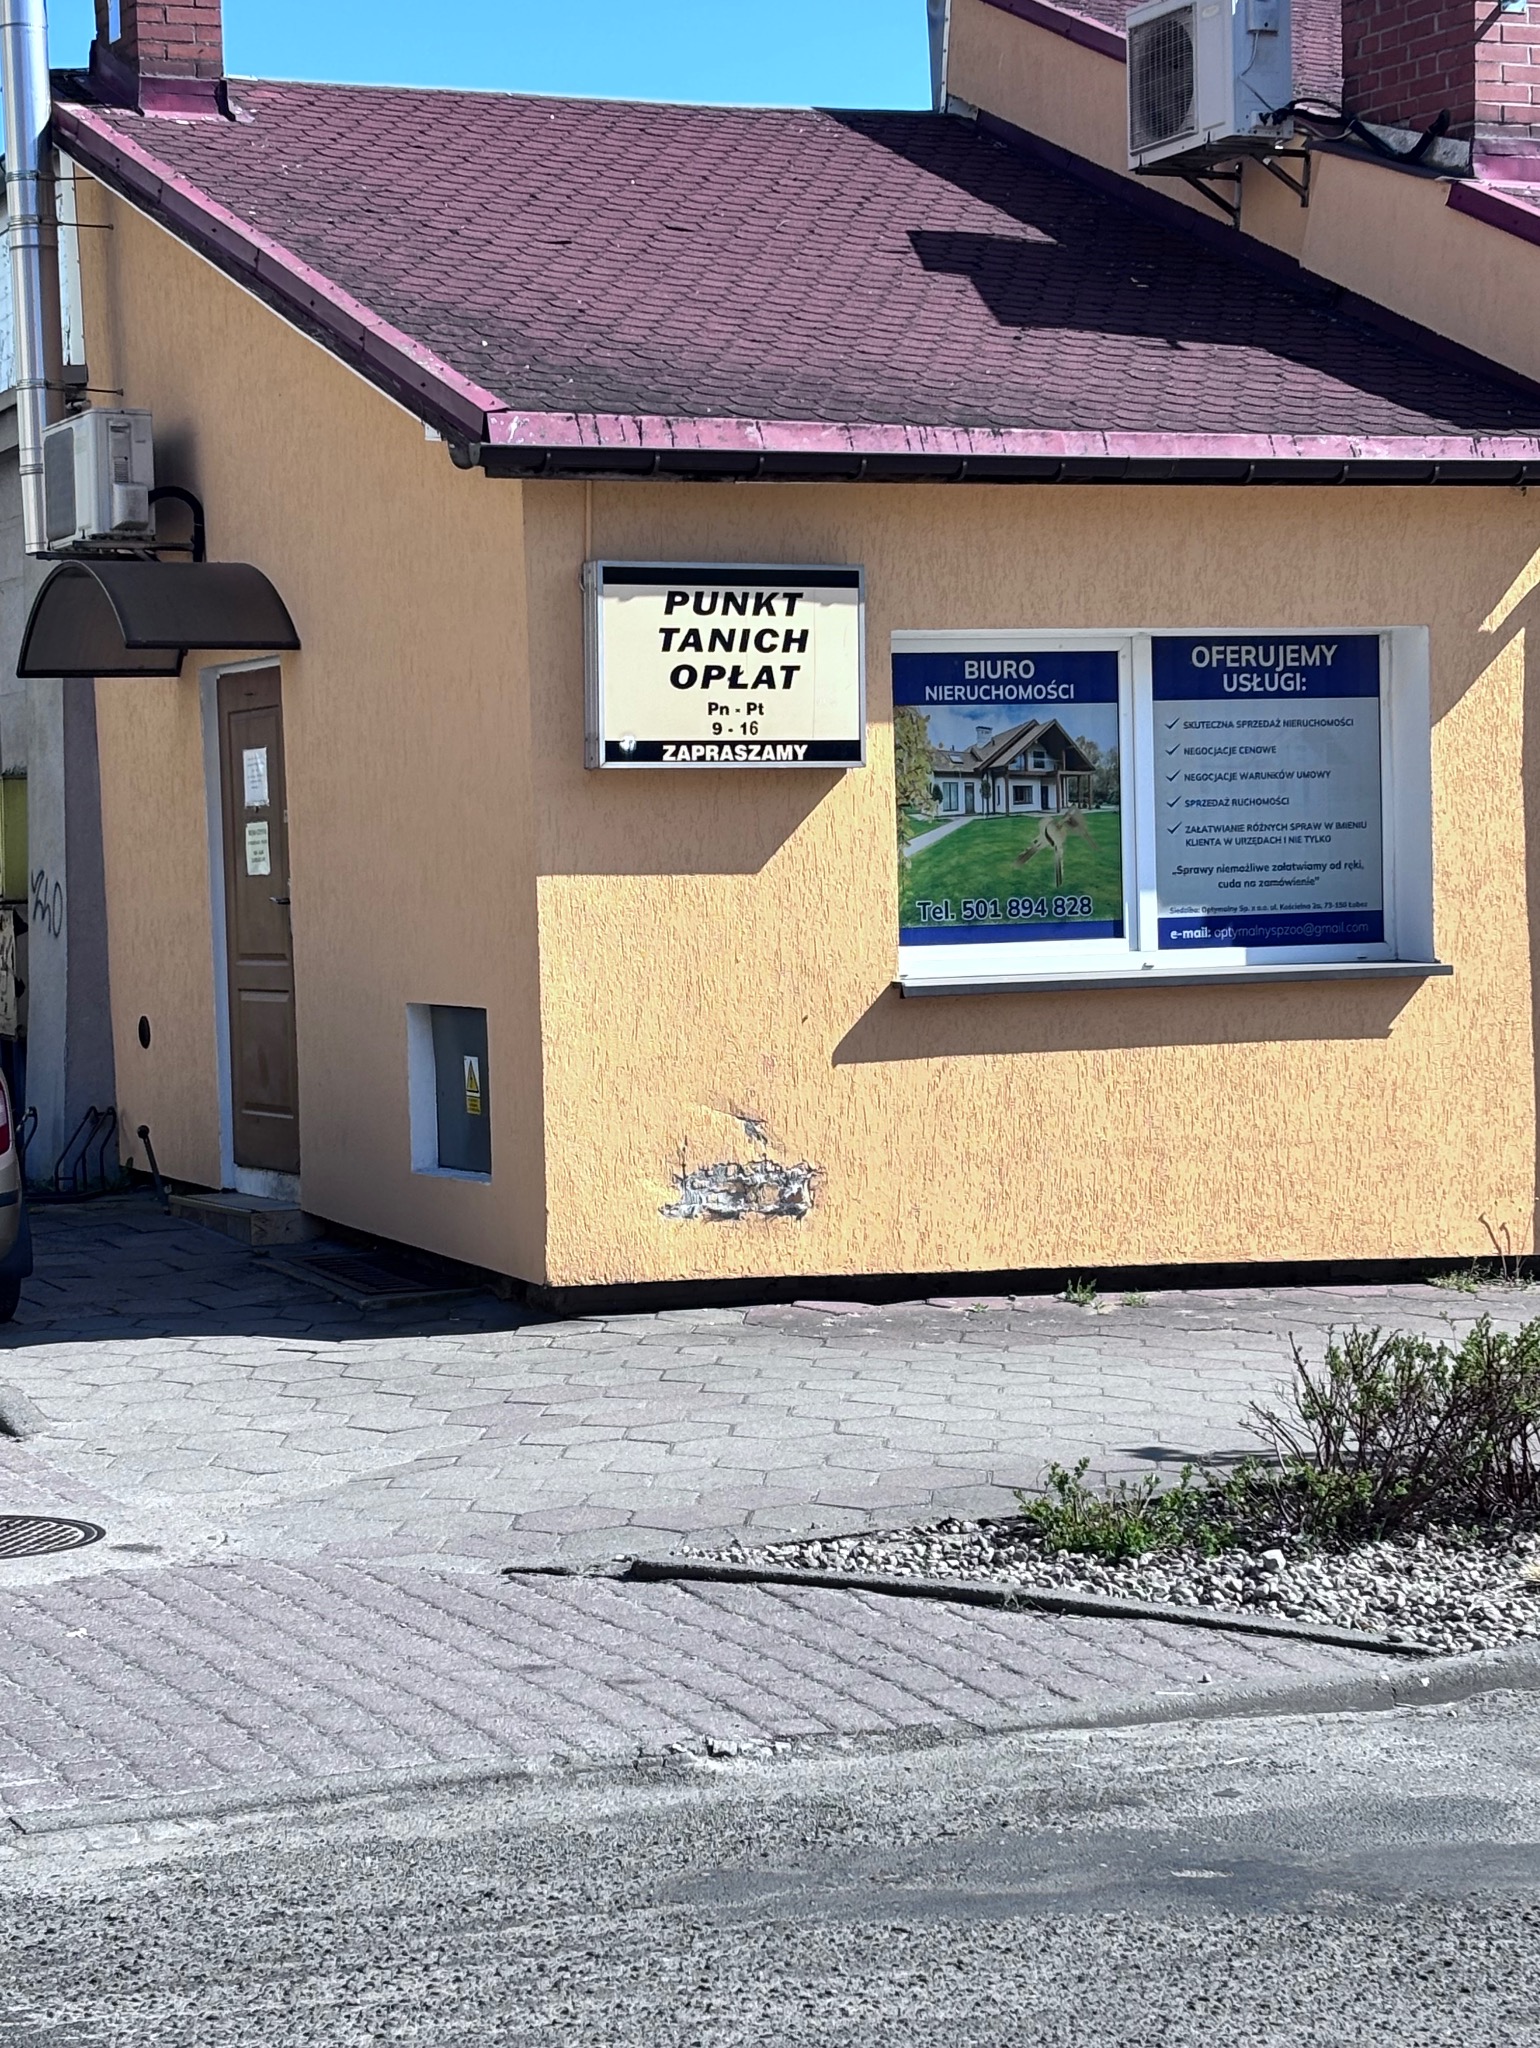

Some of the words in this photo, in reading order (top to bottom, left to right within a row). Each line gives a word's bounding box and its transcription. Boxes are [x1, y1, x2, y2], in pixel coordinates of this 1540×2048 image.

[664, 590, 804, 617] PUNKT
[658, 627, 809, 653] TANICH
[1191, 644, 1338, 671] OFERUJEMY
[669, 664, 801, 690] OPŁAT
[964, 659, 1035, 680] BIURO
[925, 680, 1075, 701] NIERUCHOMOŚCI
[1222, 673, 1307, 693] USŁUGI:
[707, 702, 730, 716] Pn
[746, 702, 764, 716] Pt
[712, 722, 723, 735] 9
[740, 721, 758, 735] 16
[1183, 721, 1235, 730] SKUTECZNA
[1236, 718, 1281, 728] SPRZEDAŻ
[1282, 717, 1354, 728] NIERUCHOMOŚCI
[662, 744, 808, 762] ZAPRASZAMY
[1183, 746, 1237, 757] NEGOCJACJE
[1239, 746, 1277, 754] CENOWE
[1184, 772, 1238, 783] NEGOCJACJE
[1240, 769, 1295, 780] WARUNKÓW
[1297, 770, 1331, 779] UMOWY
[1184, 797, 1230, 808] SPRZEDAŻ
[1232, 795, 1290, 806] RUCHOMOŚCI
[1185, 824, 1245, 834] ZAŁATWIANIE
[1246, 821, 1288, 832] RÓŻNYCH
[1290, 822, 1322, 832] SPRAW
[1323, 822, 1335, 830] W
[1335, 821, 1368, 830] IMIENIU
[1185, 837, 1222, 847] KLIENTA
[1223, 837, 1234, 846] W
[1235, 835, 1282, 847] URZĘDACH
[1288, 835, 1303, 844] NIE
[1304, 834, 1332, 844] TYLKO
[1216, 863, 1270, 874] niemożliwe
[1271, 861, 1327, 874] załatwiamy
[1329, 860, 1342, 870] od
[1343, 860, 1365, 870] ręki,
[1218, 878, 1241, 889] cuda
[916, 900, 956, 922] Tel.
[961, 898, 1002, 920] 501
[1007, 896, 1047, 919] 894
[1052, 896, 1092, 917] 828
[1170, 926, 1212, 939] e-mail:
[1214, 922, 1369, 940] optymalnyspzoo@gmail.com
